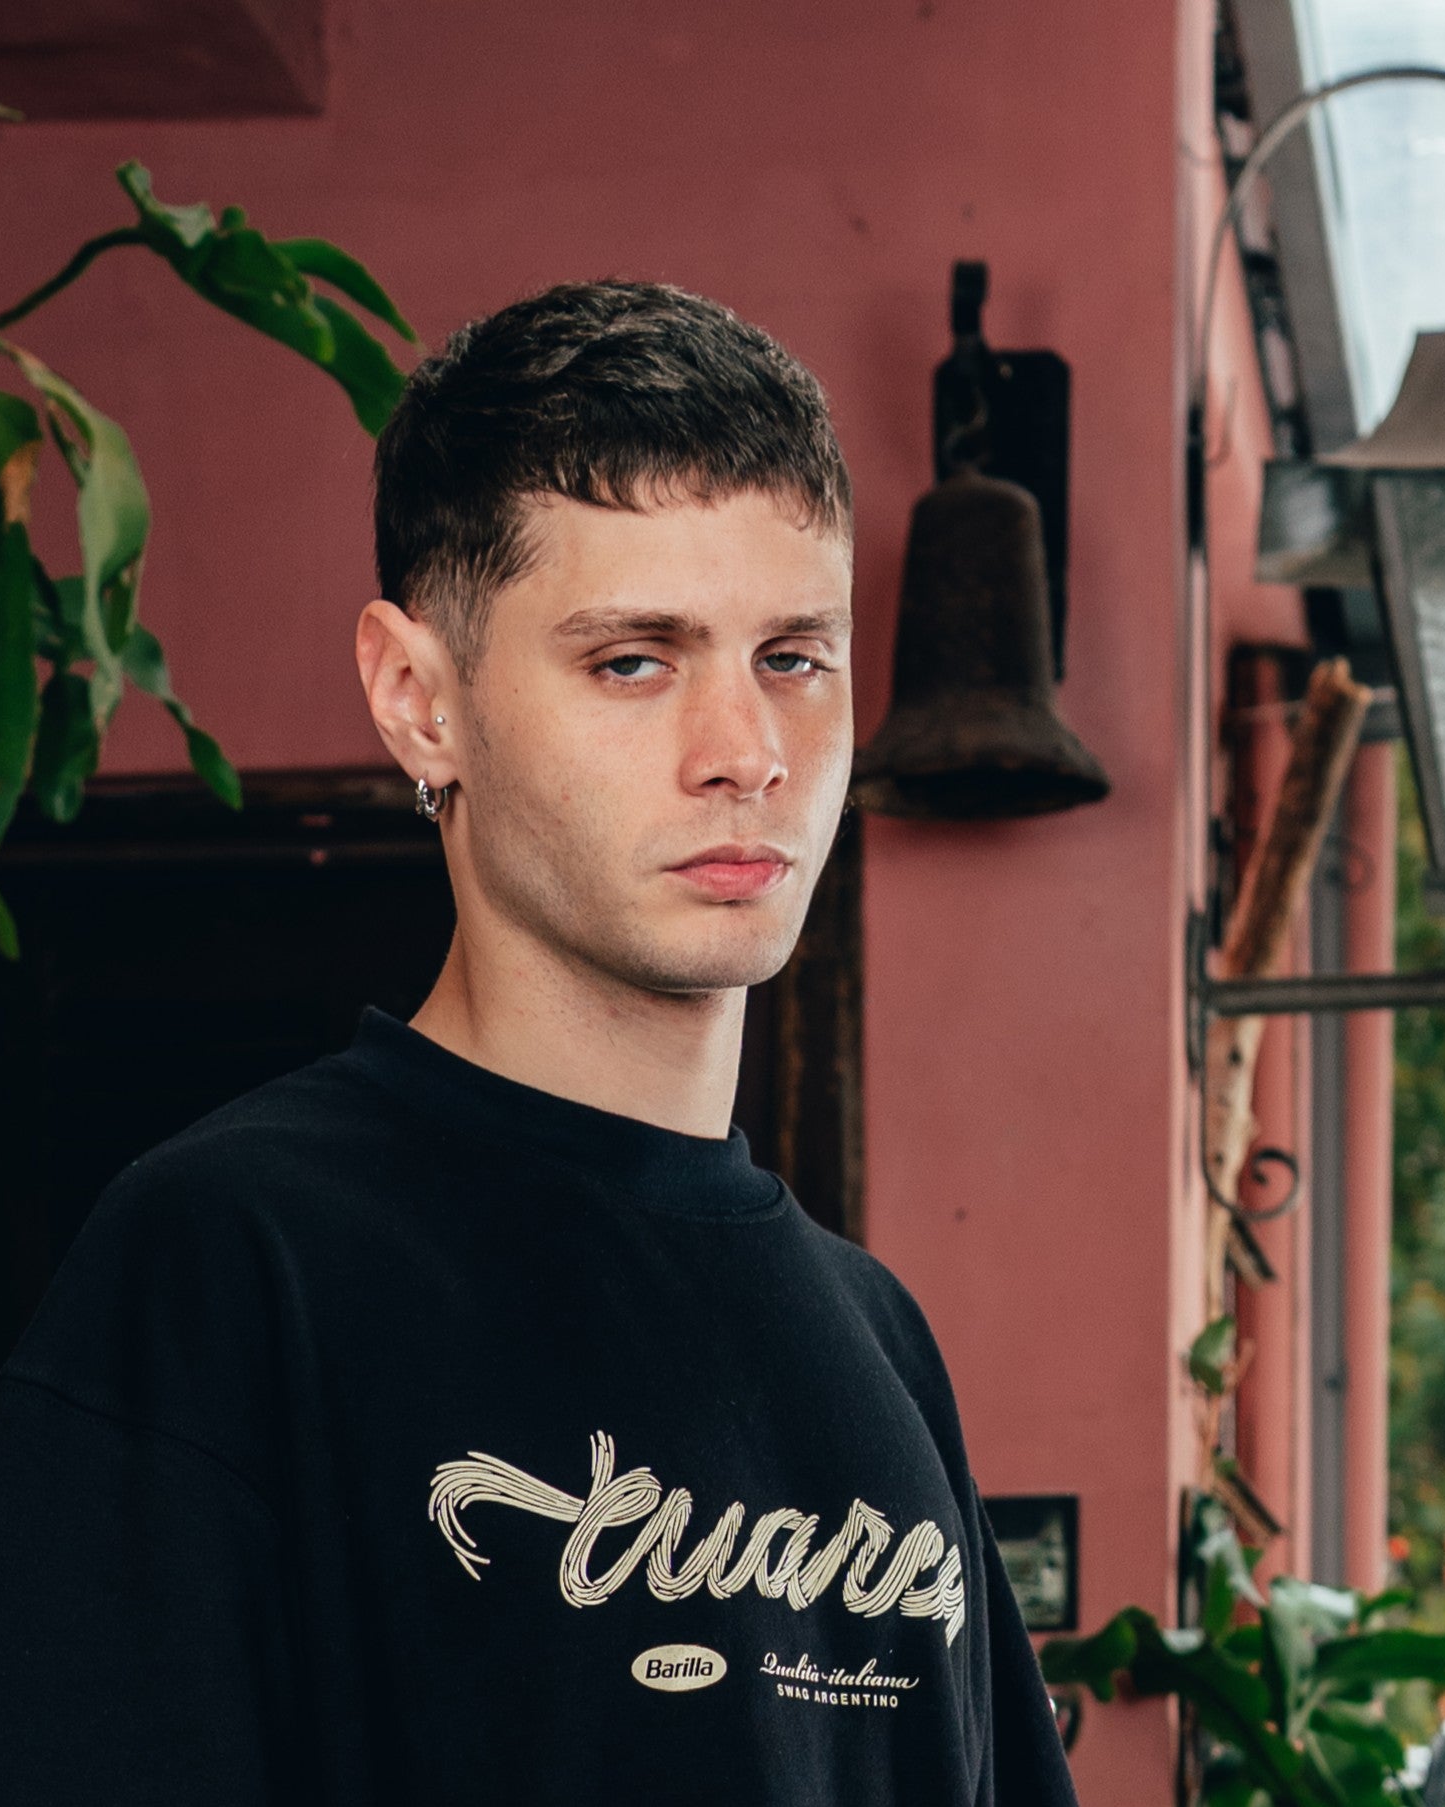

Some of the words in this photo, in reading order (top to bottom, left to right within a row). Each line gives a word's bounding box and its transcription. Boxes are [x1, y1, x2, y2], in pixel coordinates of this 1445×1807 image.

[645, 1657, 714, 1680] Barilla
[777, 1683, 809, 1700] SWAG
[814, 1690, 899, 1708] ARGENTINO
